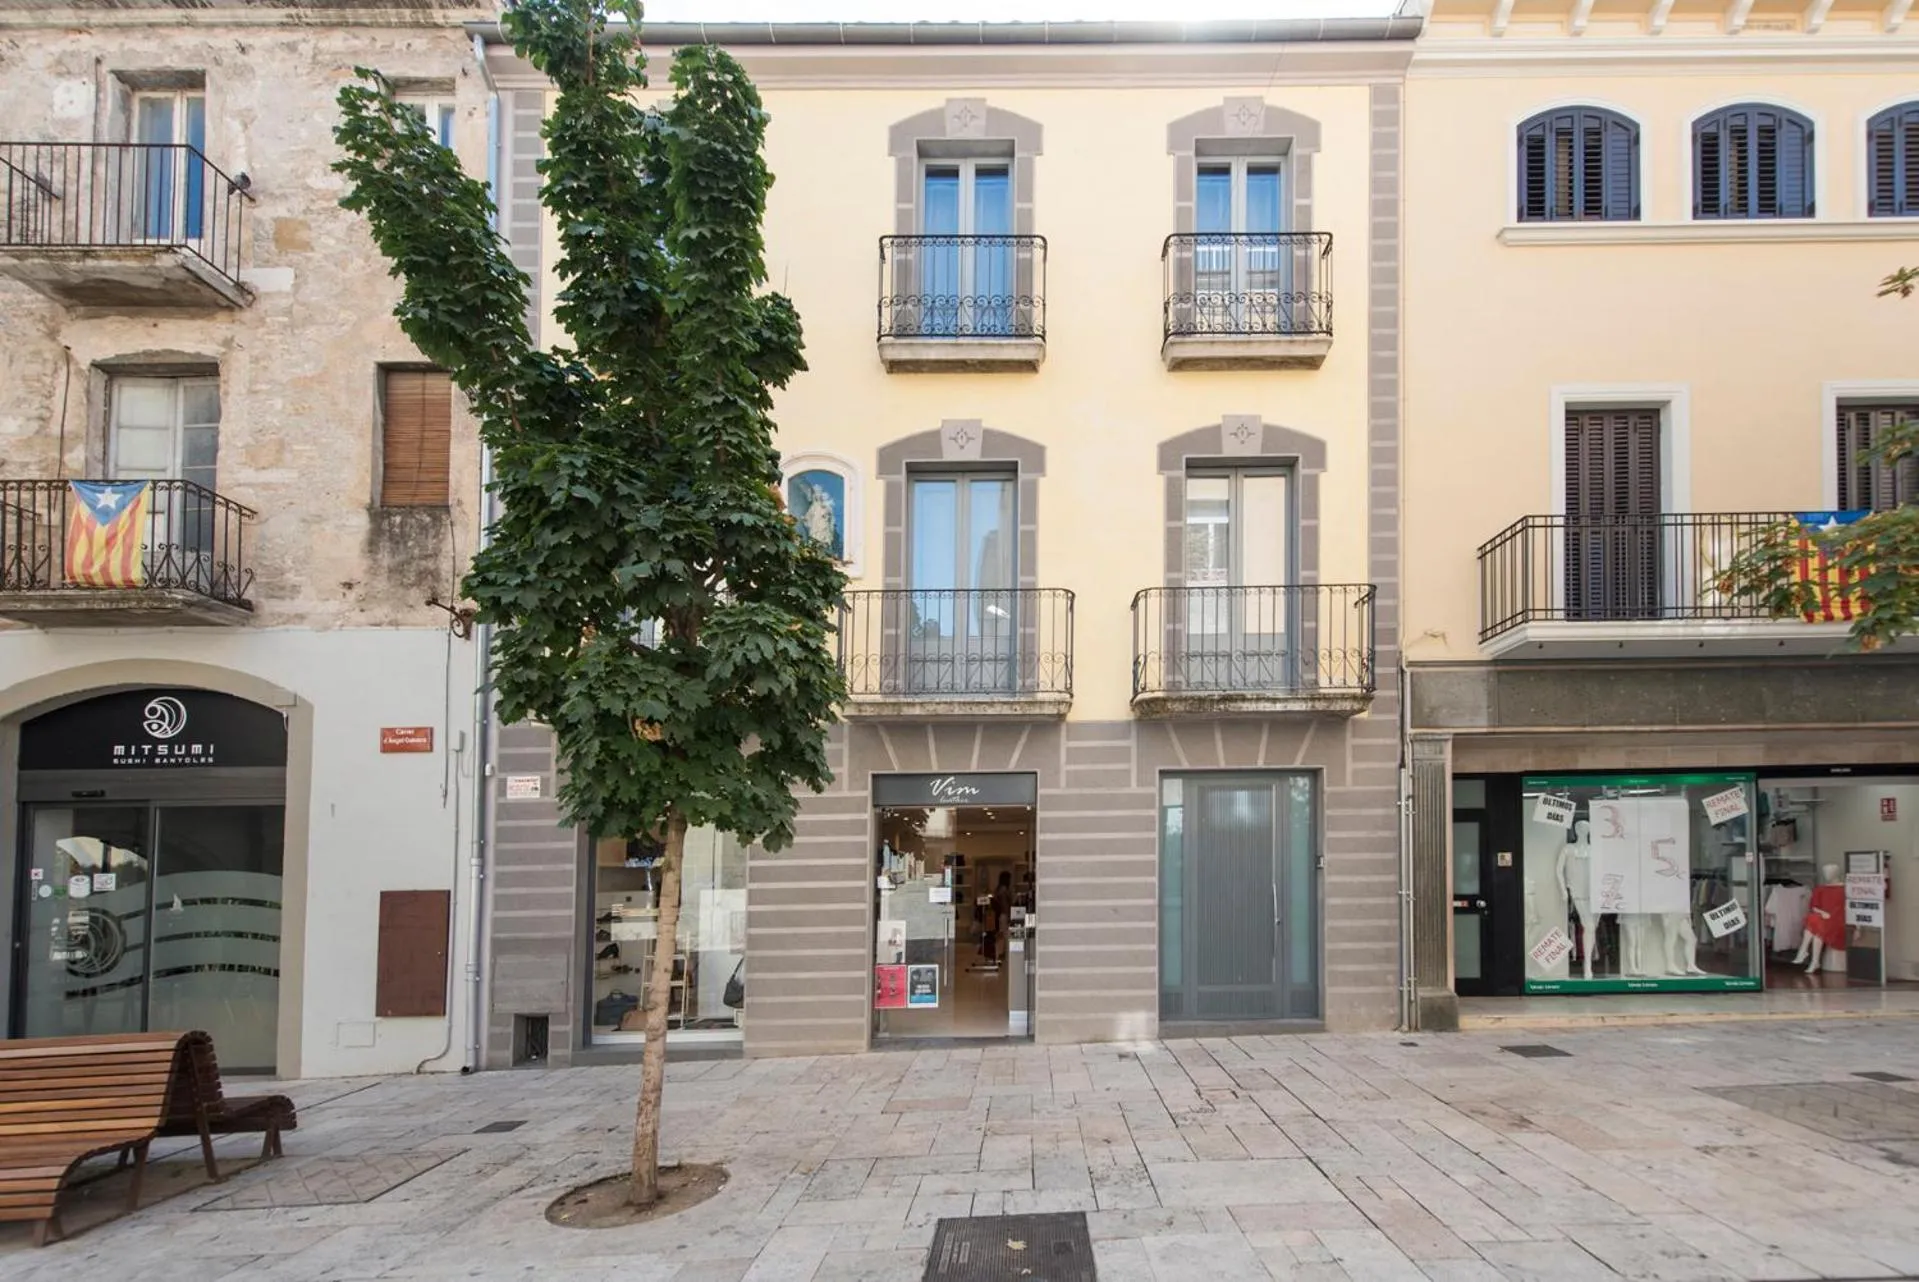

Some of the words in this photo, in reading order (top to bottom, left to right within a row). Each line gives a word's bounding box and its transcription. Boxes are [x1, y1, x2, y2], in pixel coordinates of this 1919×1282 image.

[113, 744, 214, 756] MITSUMI
[929, 776, 980, 796] Vim
[1706, 790, 1741, 808] REMATE
[1714, 803, 1741, 818] FINAL
[1532, 929, 1563, 960] REMATE
[1545, 943, 1567, 963] FINAL
